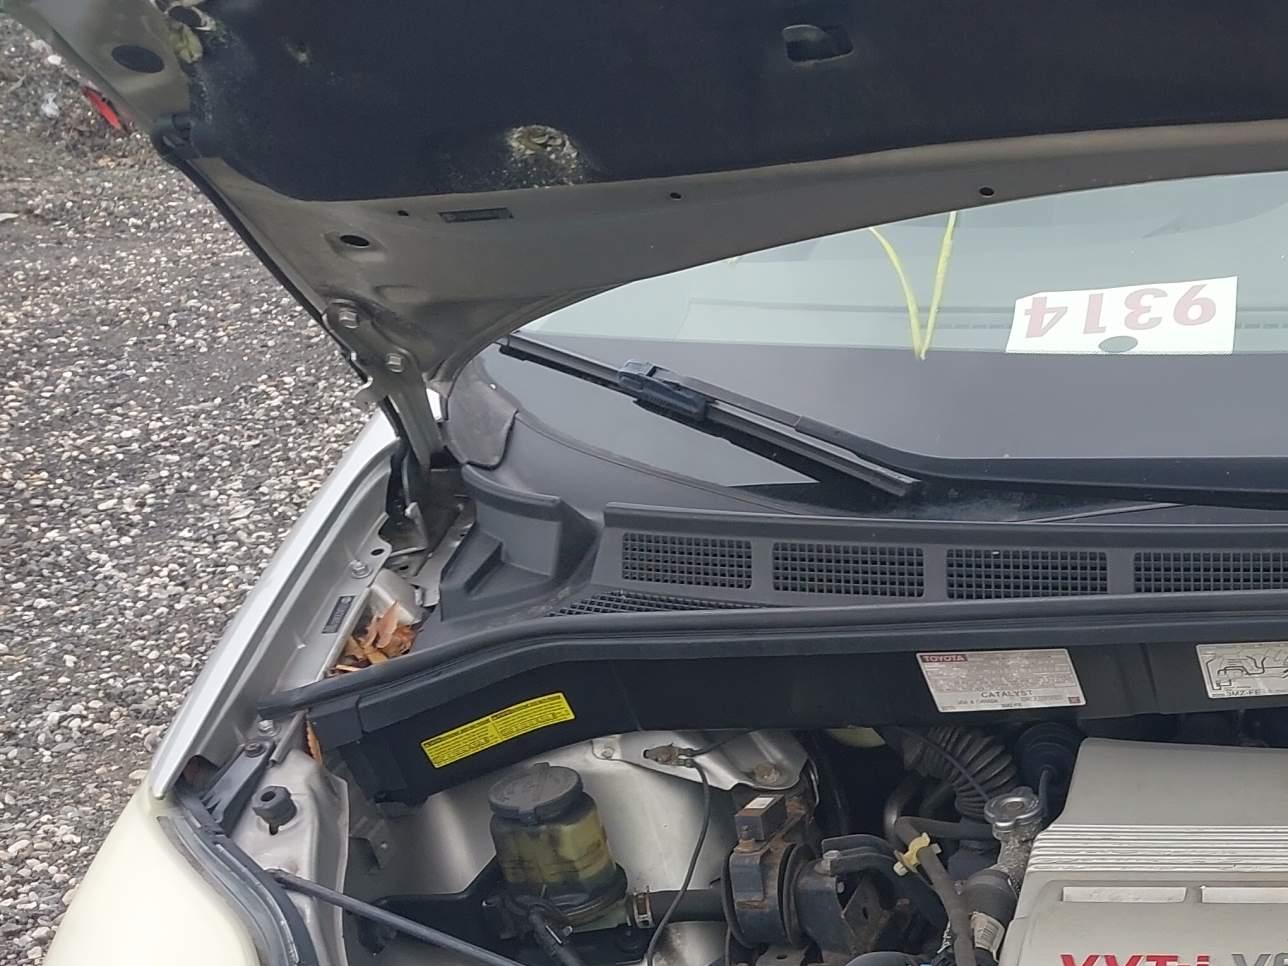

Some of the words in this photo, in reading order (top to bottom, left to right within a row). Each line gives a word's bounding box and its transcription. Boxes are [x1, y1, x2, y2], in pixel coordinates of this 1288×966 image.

[1024, 284, 1217, 338] 9314
[923, 654, 966, 662] TOYOTA
[980, 689, 1033, 698] CATALYST
